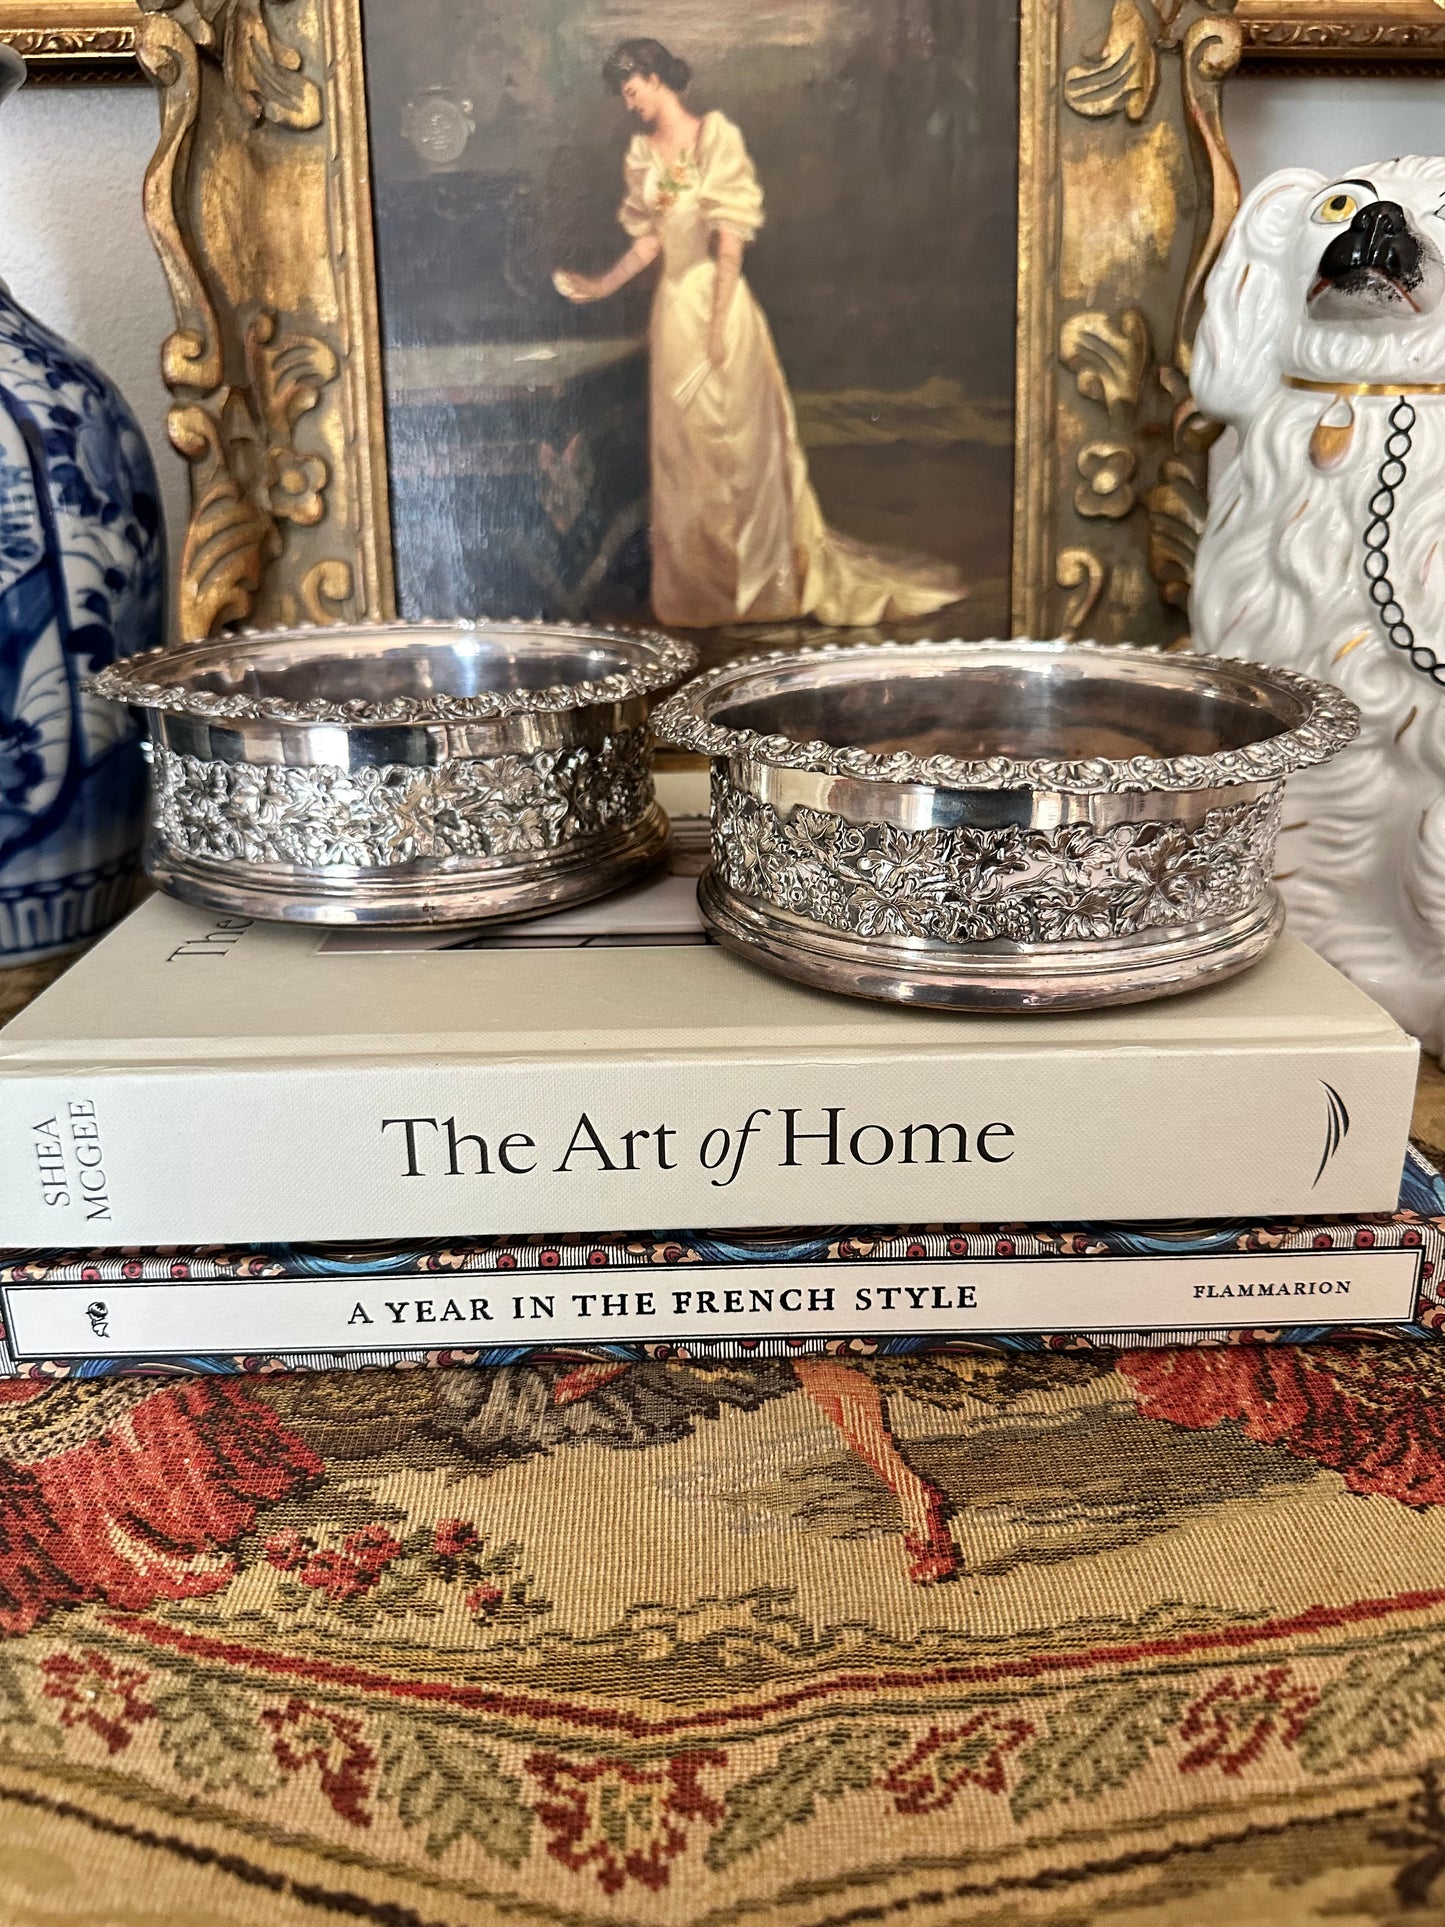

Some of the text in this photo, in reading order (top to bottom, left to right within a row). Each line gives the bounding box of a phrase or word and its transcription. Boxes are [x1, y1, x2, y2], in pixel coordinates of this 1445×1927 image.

[166, 918, 254, 962] The
[32, 1114, 71, 1208] SHEA
[68, 1099, 112, 1222] MCGEE
[381, 1107, 1016, 1187] The Art of Home
[347, 1285, 978, 1326] A YEAR IN THE FRENCH STYLE
[1192, 1279, 1352, 1300] FLAMMARION
